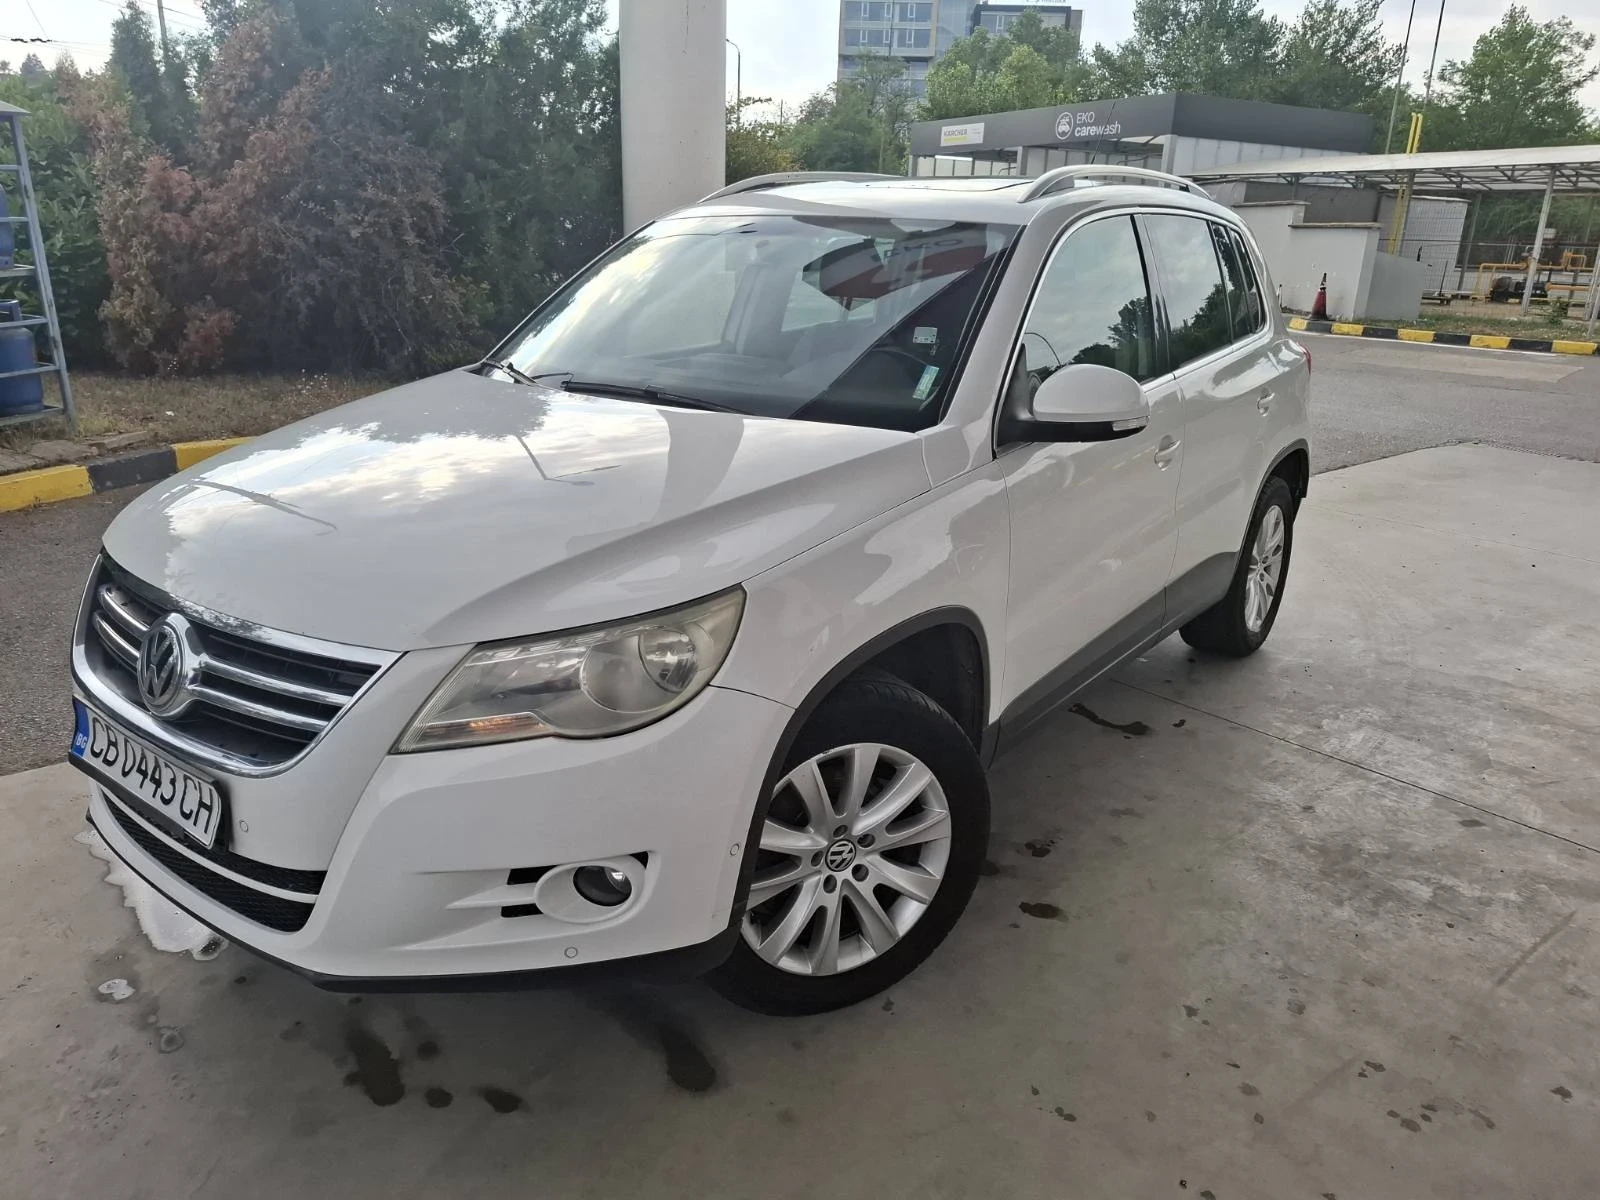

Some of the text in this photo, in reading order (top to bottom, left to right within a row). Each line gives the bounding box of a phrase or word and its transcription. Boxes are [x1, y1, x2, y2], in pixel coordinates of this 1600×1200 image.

[1076, 112, 1095, 124] EKO
[1074, 121, 1121, 137] carewash
[76, 732, 88, 749] BG
